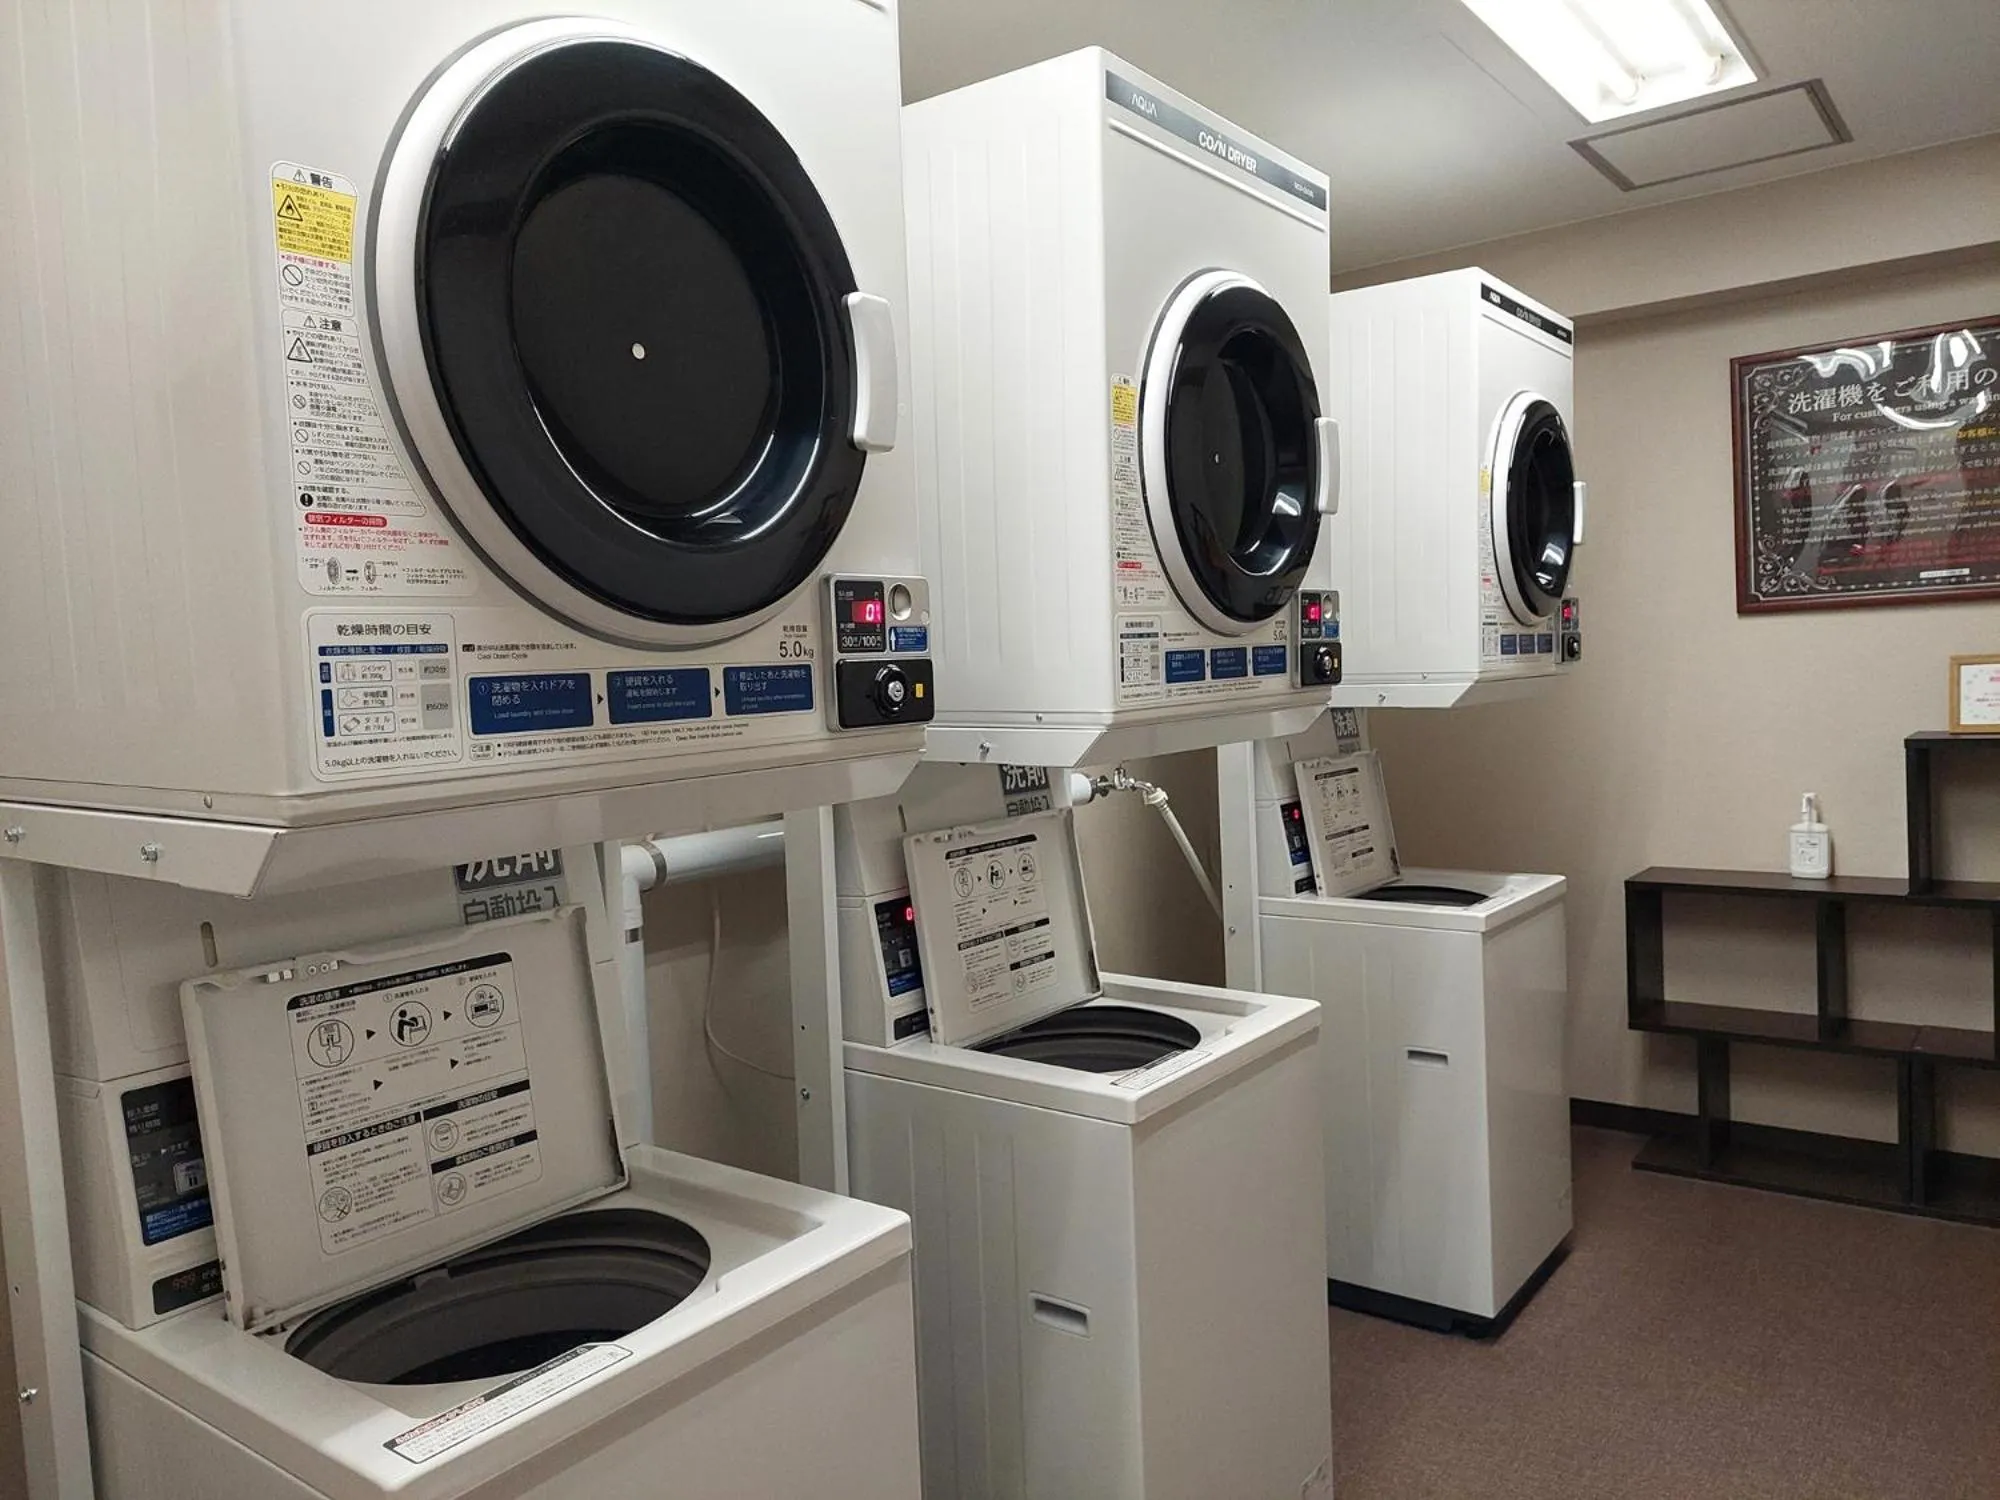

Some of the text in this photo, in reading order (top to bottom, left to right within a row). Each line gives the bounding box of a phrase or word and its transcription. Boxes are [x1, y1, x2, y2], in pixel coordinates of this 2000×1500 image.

[1131, 93, 1158, 118] AQUA
[1199, 130, 1257, 174] COIN DRYER
[319, 318, 342, 332] 注意
[1832, 410, 1852, 422] For
[336, 624, 432, 636] 乾燥時間の目安
[780, 641, 814, 658] 5.0kg
[512, 652, 528, 661] Cycle
[492, 680, 576, 693] 洗濯物を入れドアを
[625, 674, 674, 686] 硬貨を入れる
[740, 682, 768, 692] 取り出す
[492, 694, 521, 707] 閉める
[463, 886, 561, 926] 自動投入
[313, 1115, 416, 1153] 硬貨を投入するときのご注意
